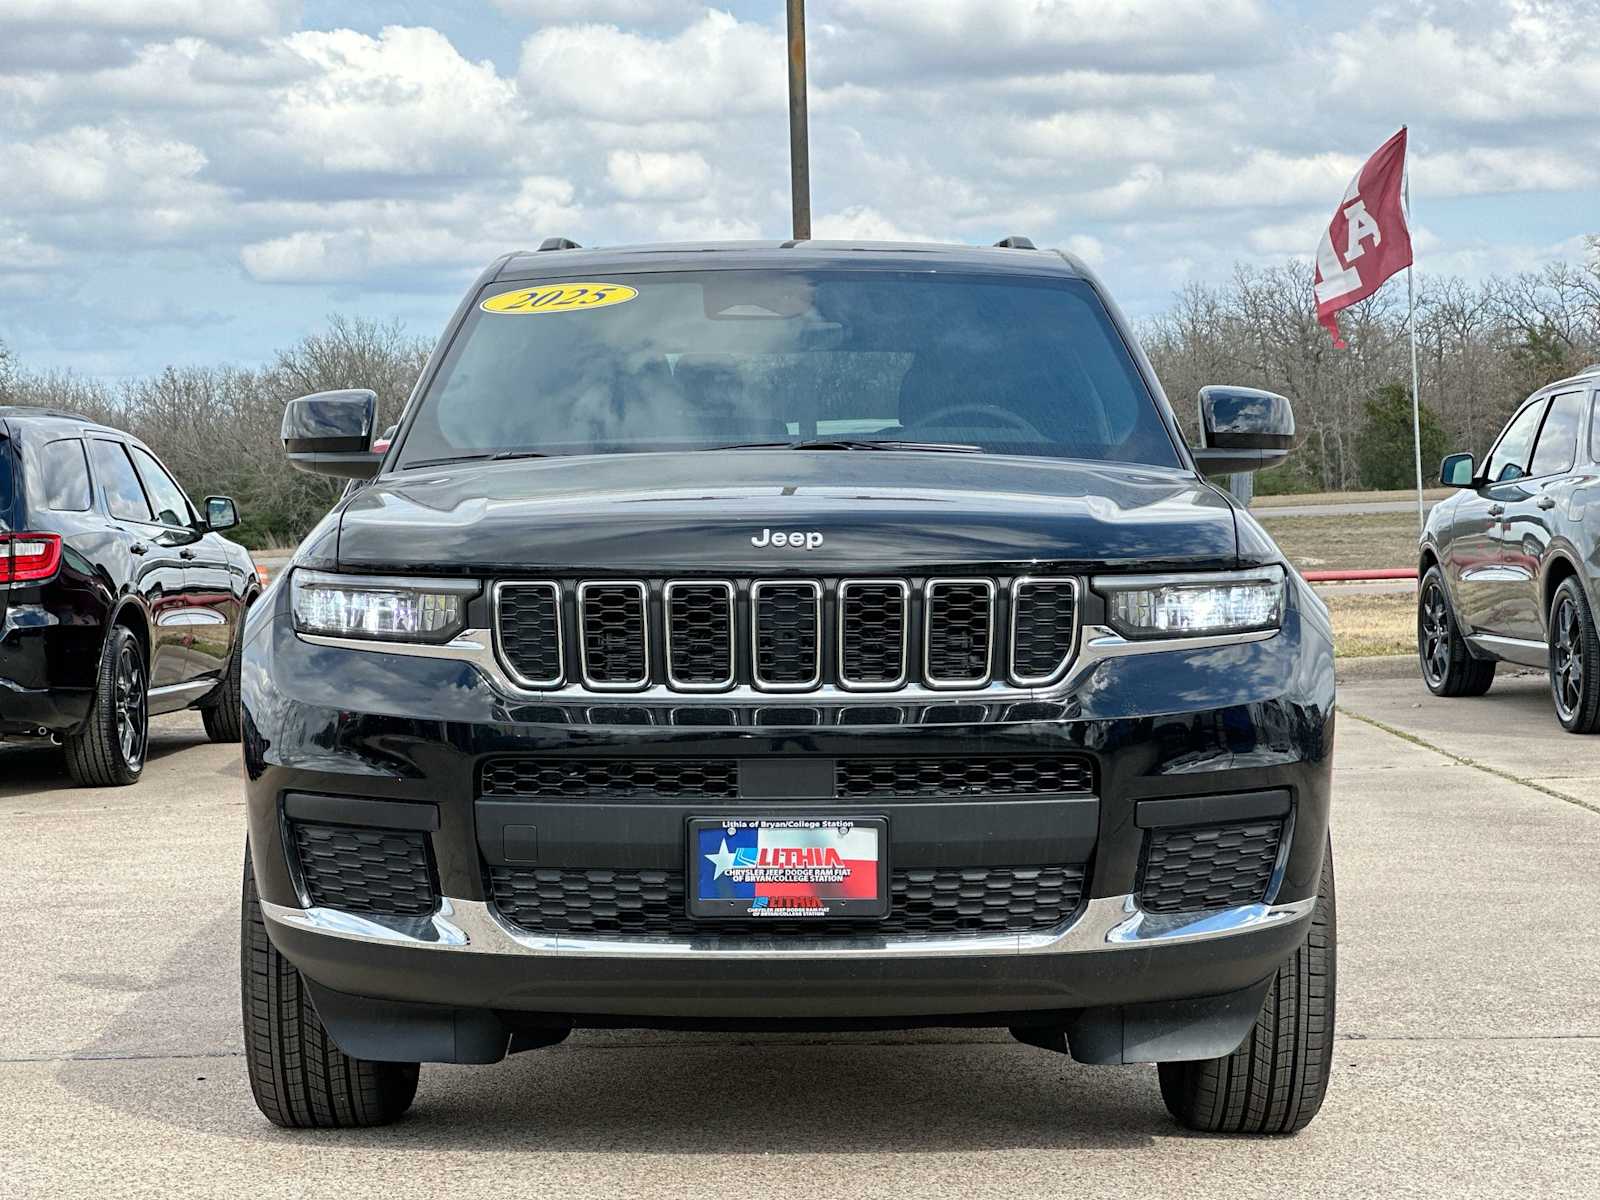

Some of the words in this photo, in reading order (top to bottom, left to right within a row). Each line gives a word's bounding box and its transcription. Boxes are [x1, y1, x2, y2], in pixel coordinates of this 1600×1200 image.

[1343, 199, 1382, 263] A
[503, 288, 617, 310] 2025
[751, 528, 824, 550] Jeep
[722, 820, 744, 828] Lithia
[748, 820, 759, 828] of
[760, 820, 820, 829] Bryan/College
[821, 820, 854, 828] Station
[757, 847, 844, 867] LITHIA
[724, 868, 765, 876] CHRYSLER
[766, 868, 784, 876] JEEP
[785, 868, 813, 876] DODGE
[815, 868, 834, 876] RAM
[834, 868, 852, 876] FIAT
